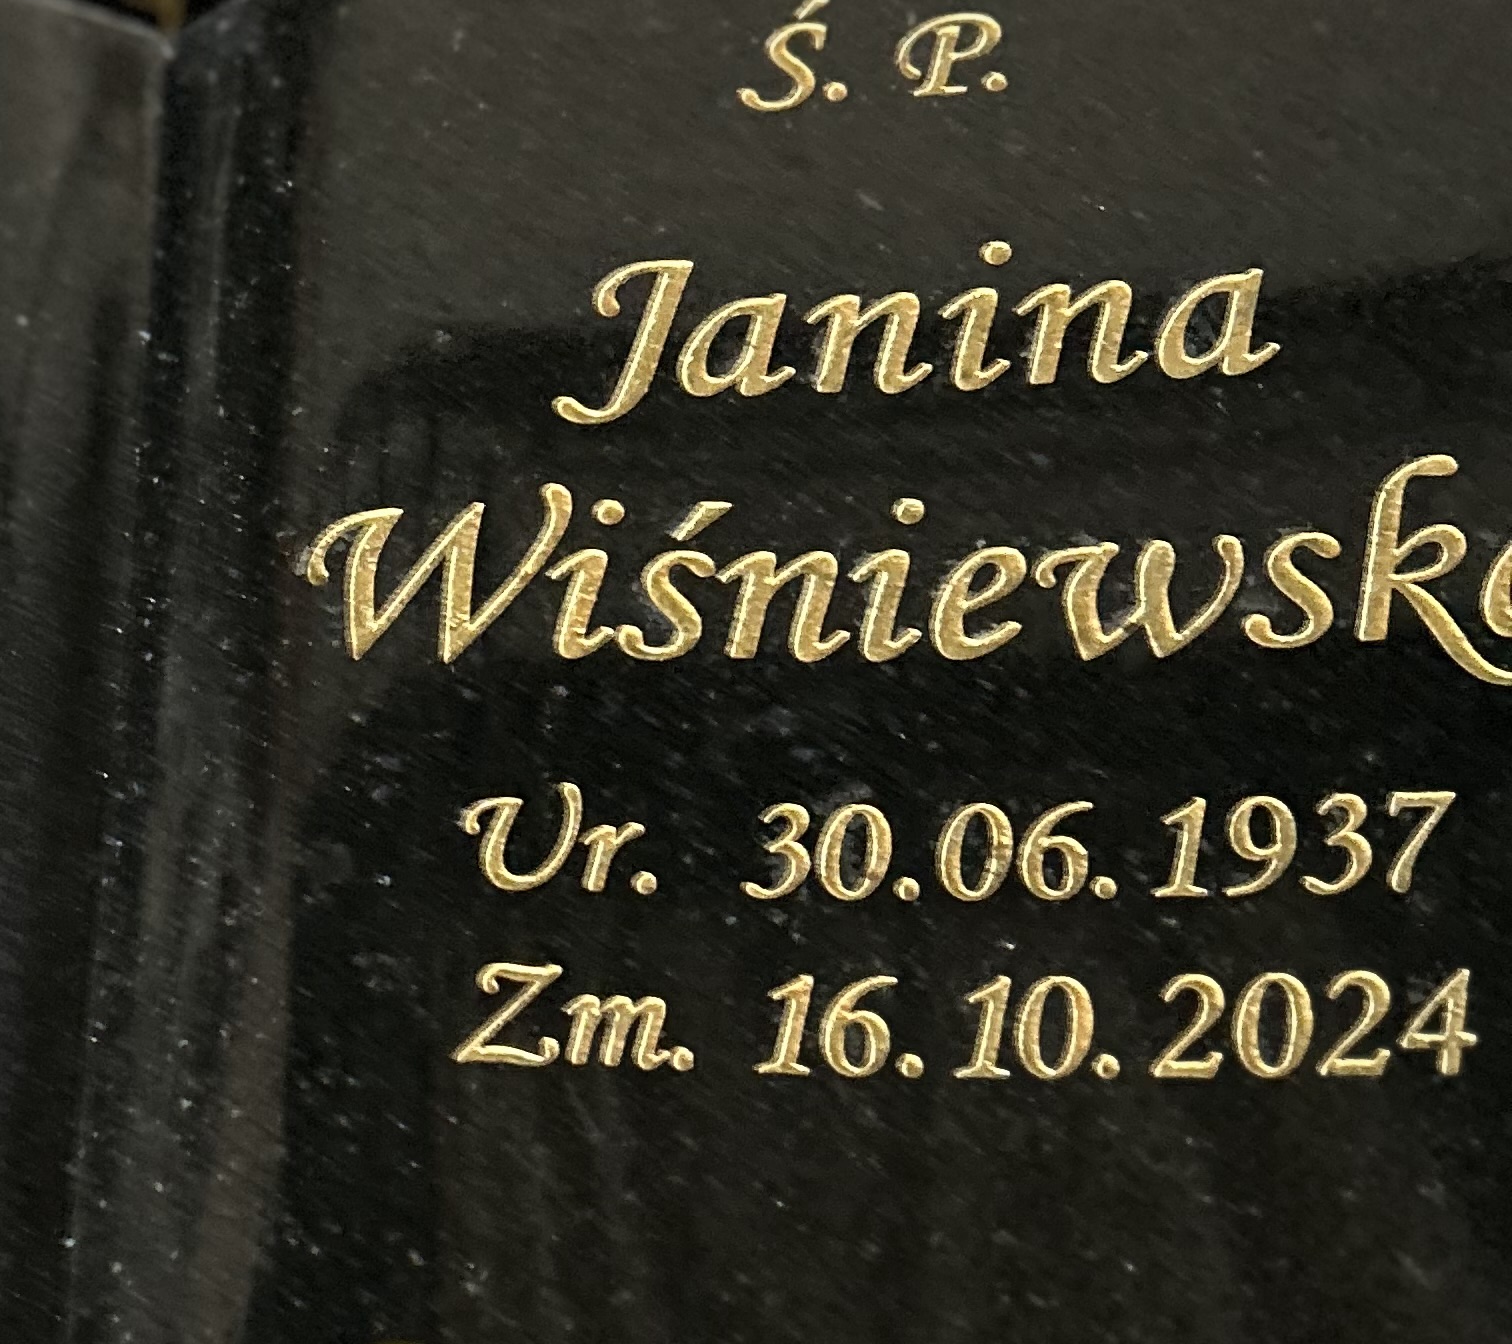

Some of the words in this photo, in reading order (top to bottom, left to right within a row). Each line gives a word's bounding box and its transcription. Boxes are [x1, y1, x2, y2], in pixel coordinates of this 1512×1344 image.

[893, 11, 1009, 98] P.
[551, 240, 1281, 425] Janina
[304, 453, 1512, 687] Wiśniewsk
[461, 781, 658, 896] Ur.
[453, 962, 694, 1072] Zm.
